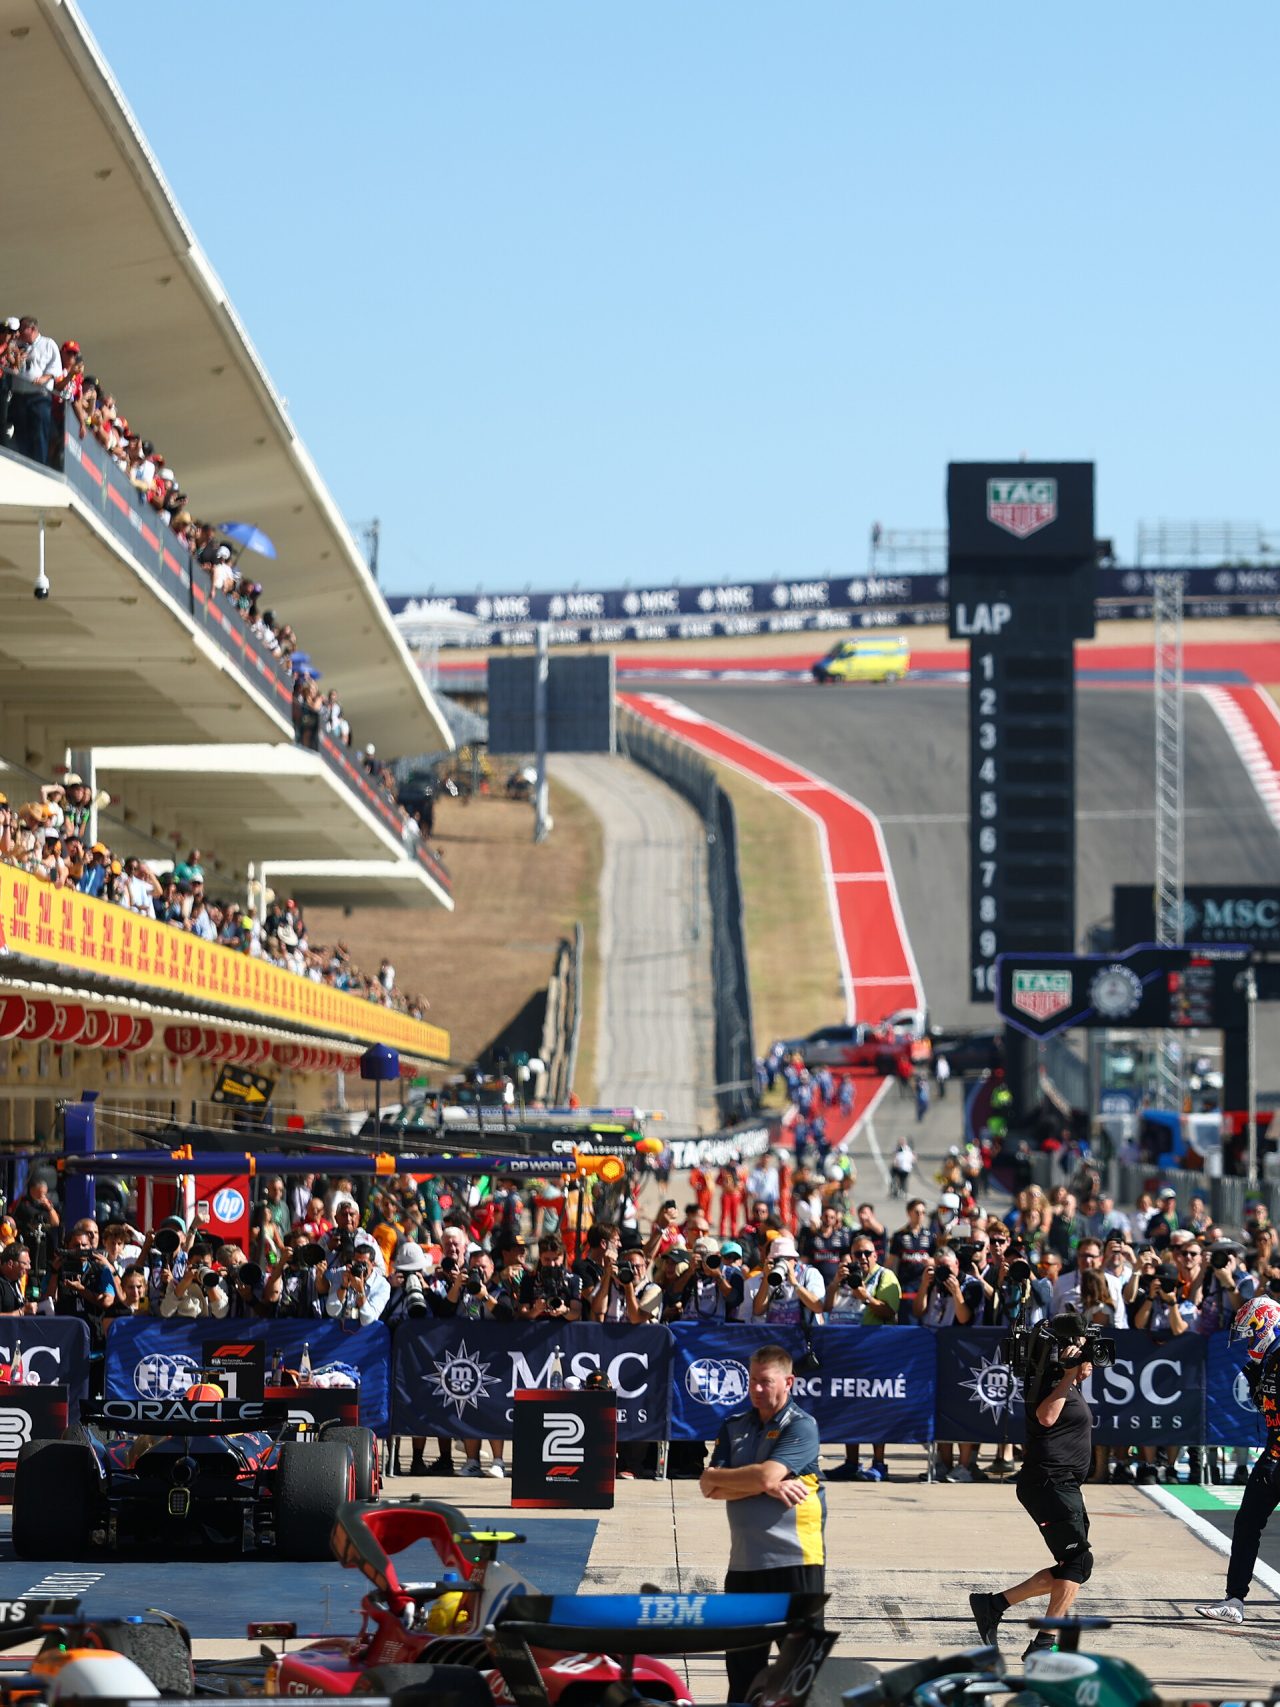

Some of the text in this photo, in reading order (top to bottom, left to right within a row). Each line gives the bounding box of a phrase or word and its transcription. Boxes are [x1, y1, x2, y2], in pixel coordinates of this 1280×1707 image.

[992, 481, 1053, 502] TAG
[955, 602, 1012, 635] LAP
[979, 653, 994, 681] 1
[979, 688, 997, 715] 2
[979, 722, 997, 750] 3
[979, 757, 997, 783] 4
[979, 791, 997, 819] 5
[979, 826, 997, 854] 6
[979, 861, 997, 888] 7
[979, 895, 997, 923] 8
[1203, 899, 1280, 928] MSC
[979, 930, 997, 957] 9
[175, 1028, 192, 1050] 13
[510, 1161, 577, 1172] DP WORLD
[216, 1191, 243, 1217] hp
[219, 1372, 237, 1399] 1
[506, 1351, 649, 1399] MSC
[689, 1367, 743, 1396] FIA
[789, 1372, 907, 1398] RC FERMÉ
[103, 1400, 264, 1420] ORACLE
[1091, 1415, 1183, 1429] UISES
[542, 1412, 585, 1462] 2
[637, 1596, 706, 1625] IBM
